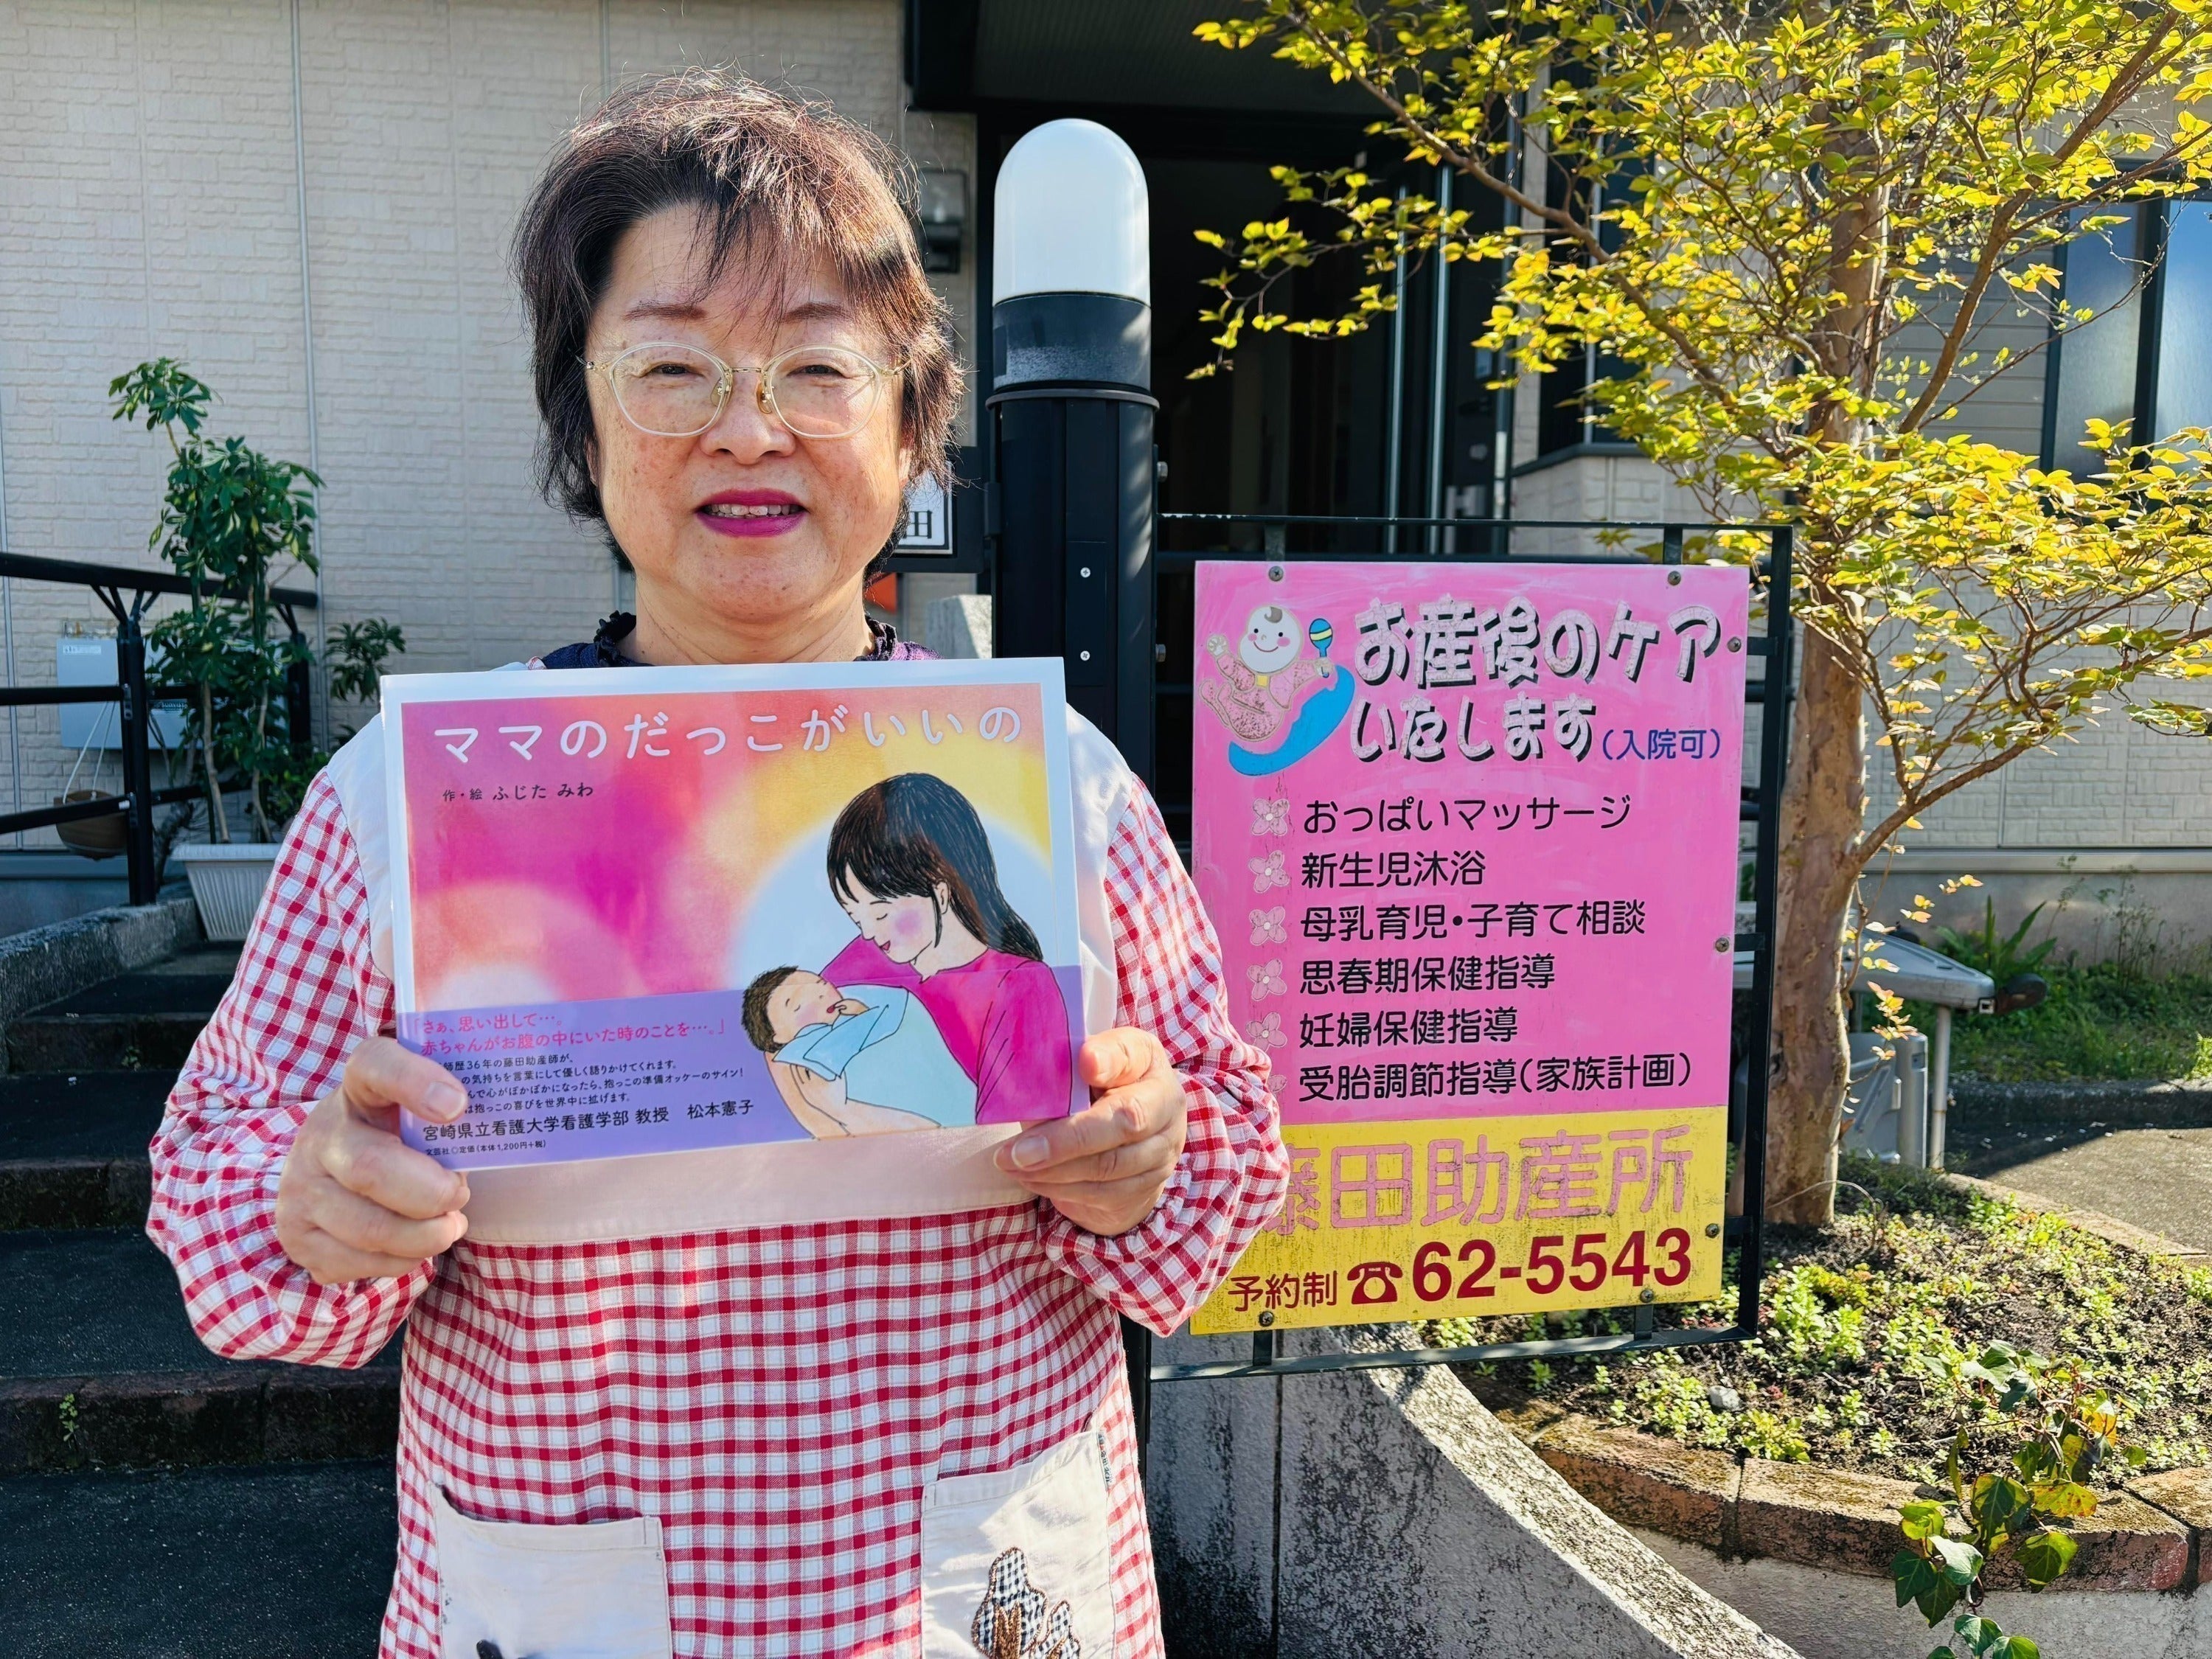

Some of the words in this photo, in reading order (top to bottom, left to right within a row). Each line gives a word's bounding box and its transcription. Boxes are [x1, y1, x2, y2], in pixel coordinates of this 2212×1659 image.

[1354, 593, 1720, 689] お産後のケア
[434, 703, 1023, 764] ママのだっこがいいの
[1351, 693, 1596, 762] いたします
[1601, 728, 1722, 760] (入院可)
[442, 788, 483, 802] 作・絵
[493, 784, 546, 801] ふじた
[557, 782, 594, 798] みわ
[1303, 794, 1632, 835] おっぱいマッサージ
[1301, 850, 1486, 889] 新生児沐浴
[1300, 900, 1646, 942] 母乳育児・子育て相談
[1299, 953, 1556, 995] 思春期保健指導
[1298, 1006, 1518, 1048] 妊婦保健指導
[1298, 1052, 1691, 1102] 受胎調節指導(家族計画)
[422, 1110, 629, 1141] 宮崎県立看護大学看護学部
[635, 1106, 670, 1124] 教授
[687, 1099, 754, 1119] 松本憲子
[1228, 1270, 1338, 1312] 予約制
[1412, 1227, 1692, 1303] 62-5543
